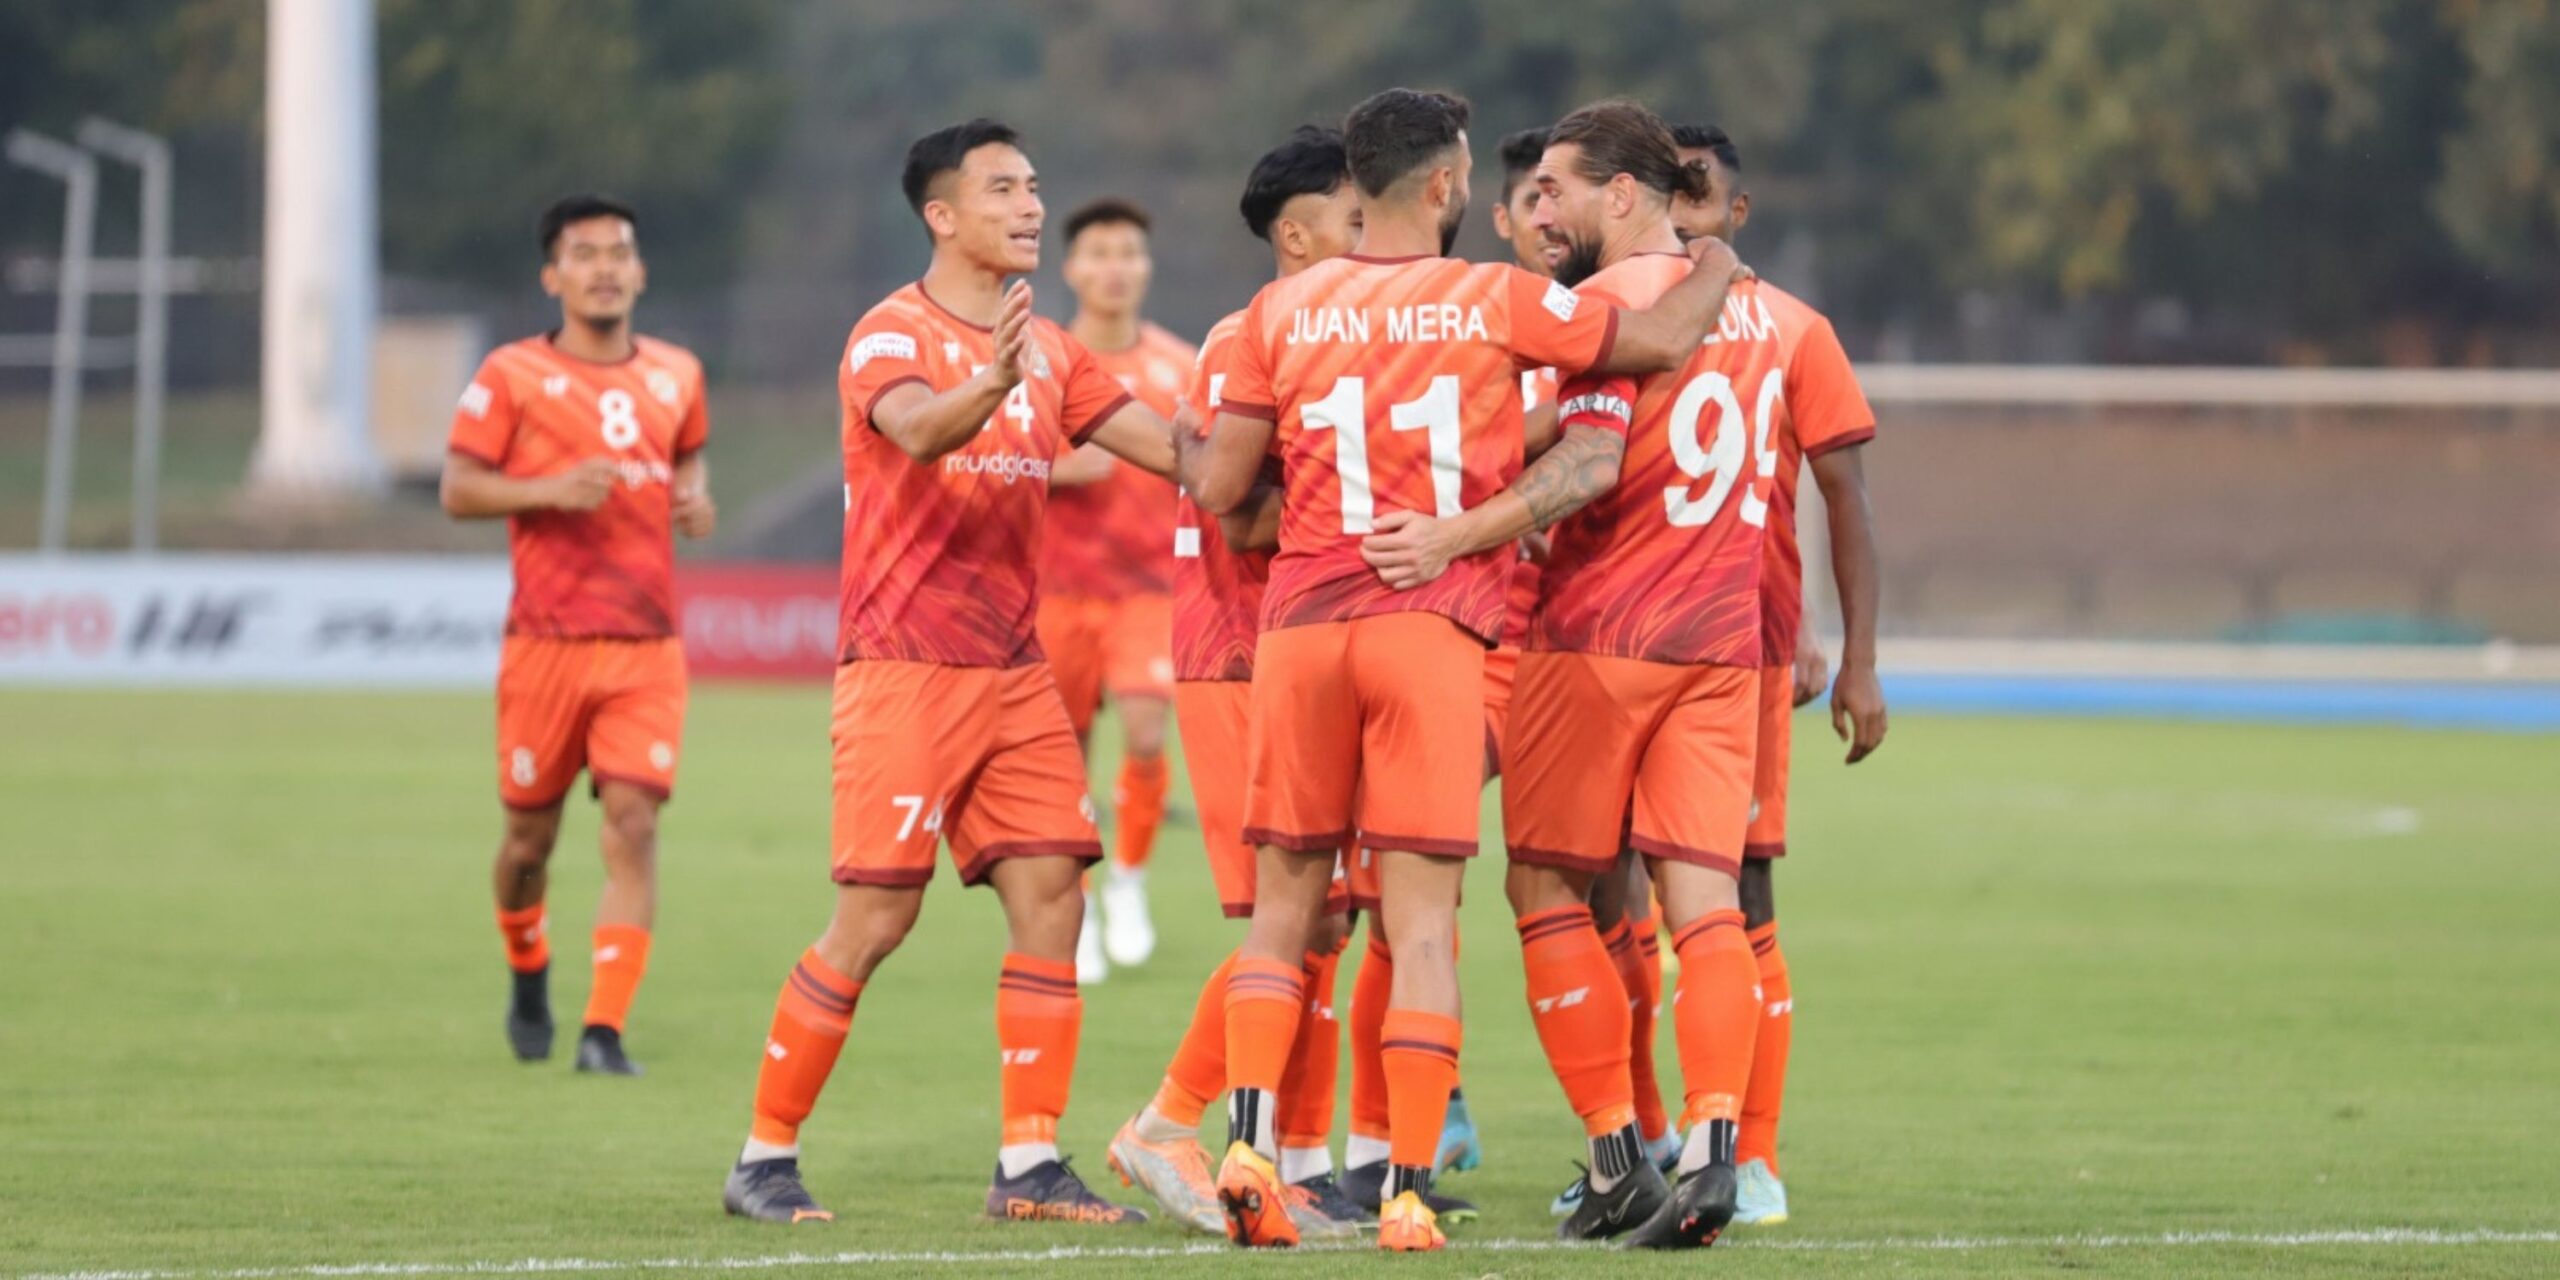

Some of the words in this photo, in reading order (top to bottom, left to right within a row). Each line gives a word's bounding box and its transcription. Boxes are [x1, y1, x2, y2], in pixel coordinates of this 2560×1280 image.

[1286, 307, 1369, 344] JUAN
[1387, 304, 1488, 343] MERA
[1702, 294, 1781, 345] UKA
[599, 388, 639, 449] 8
[971, 364, 1034, 433] 4
[1300, 375, 1464, 535] 11
[512, 746, 537, 786] 8
[892, 796, 943, 841] 74
